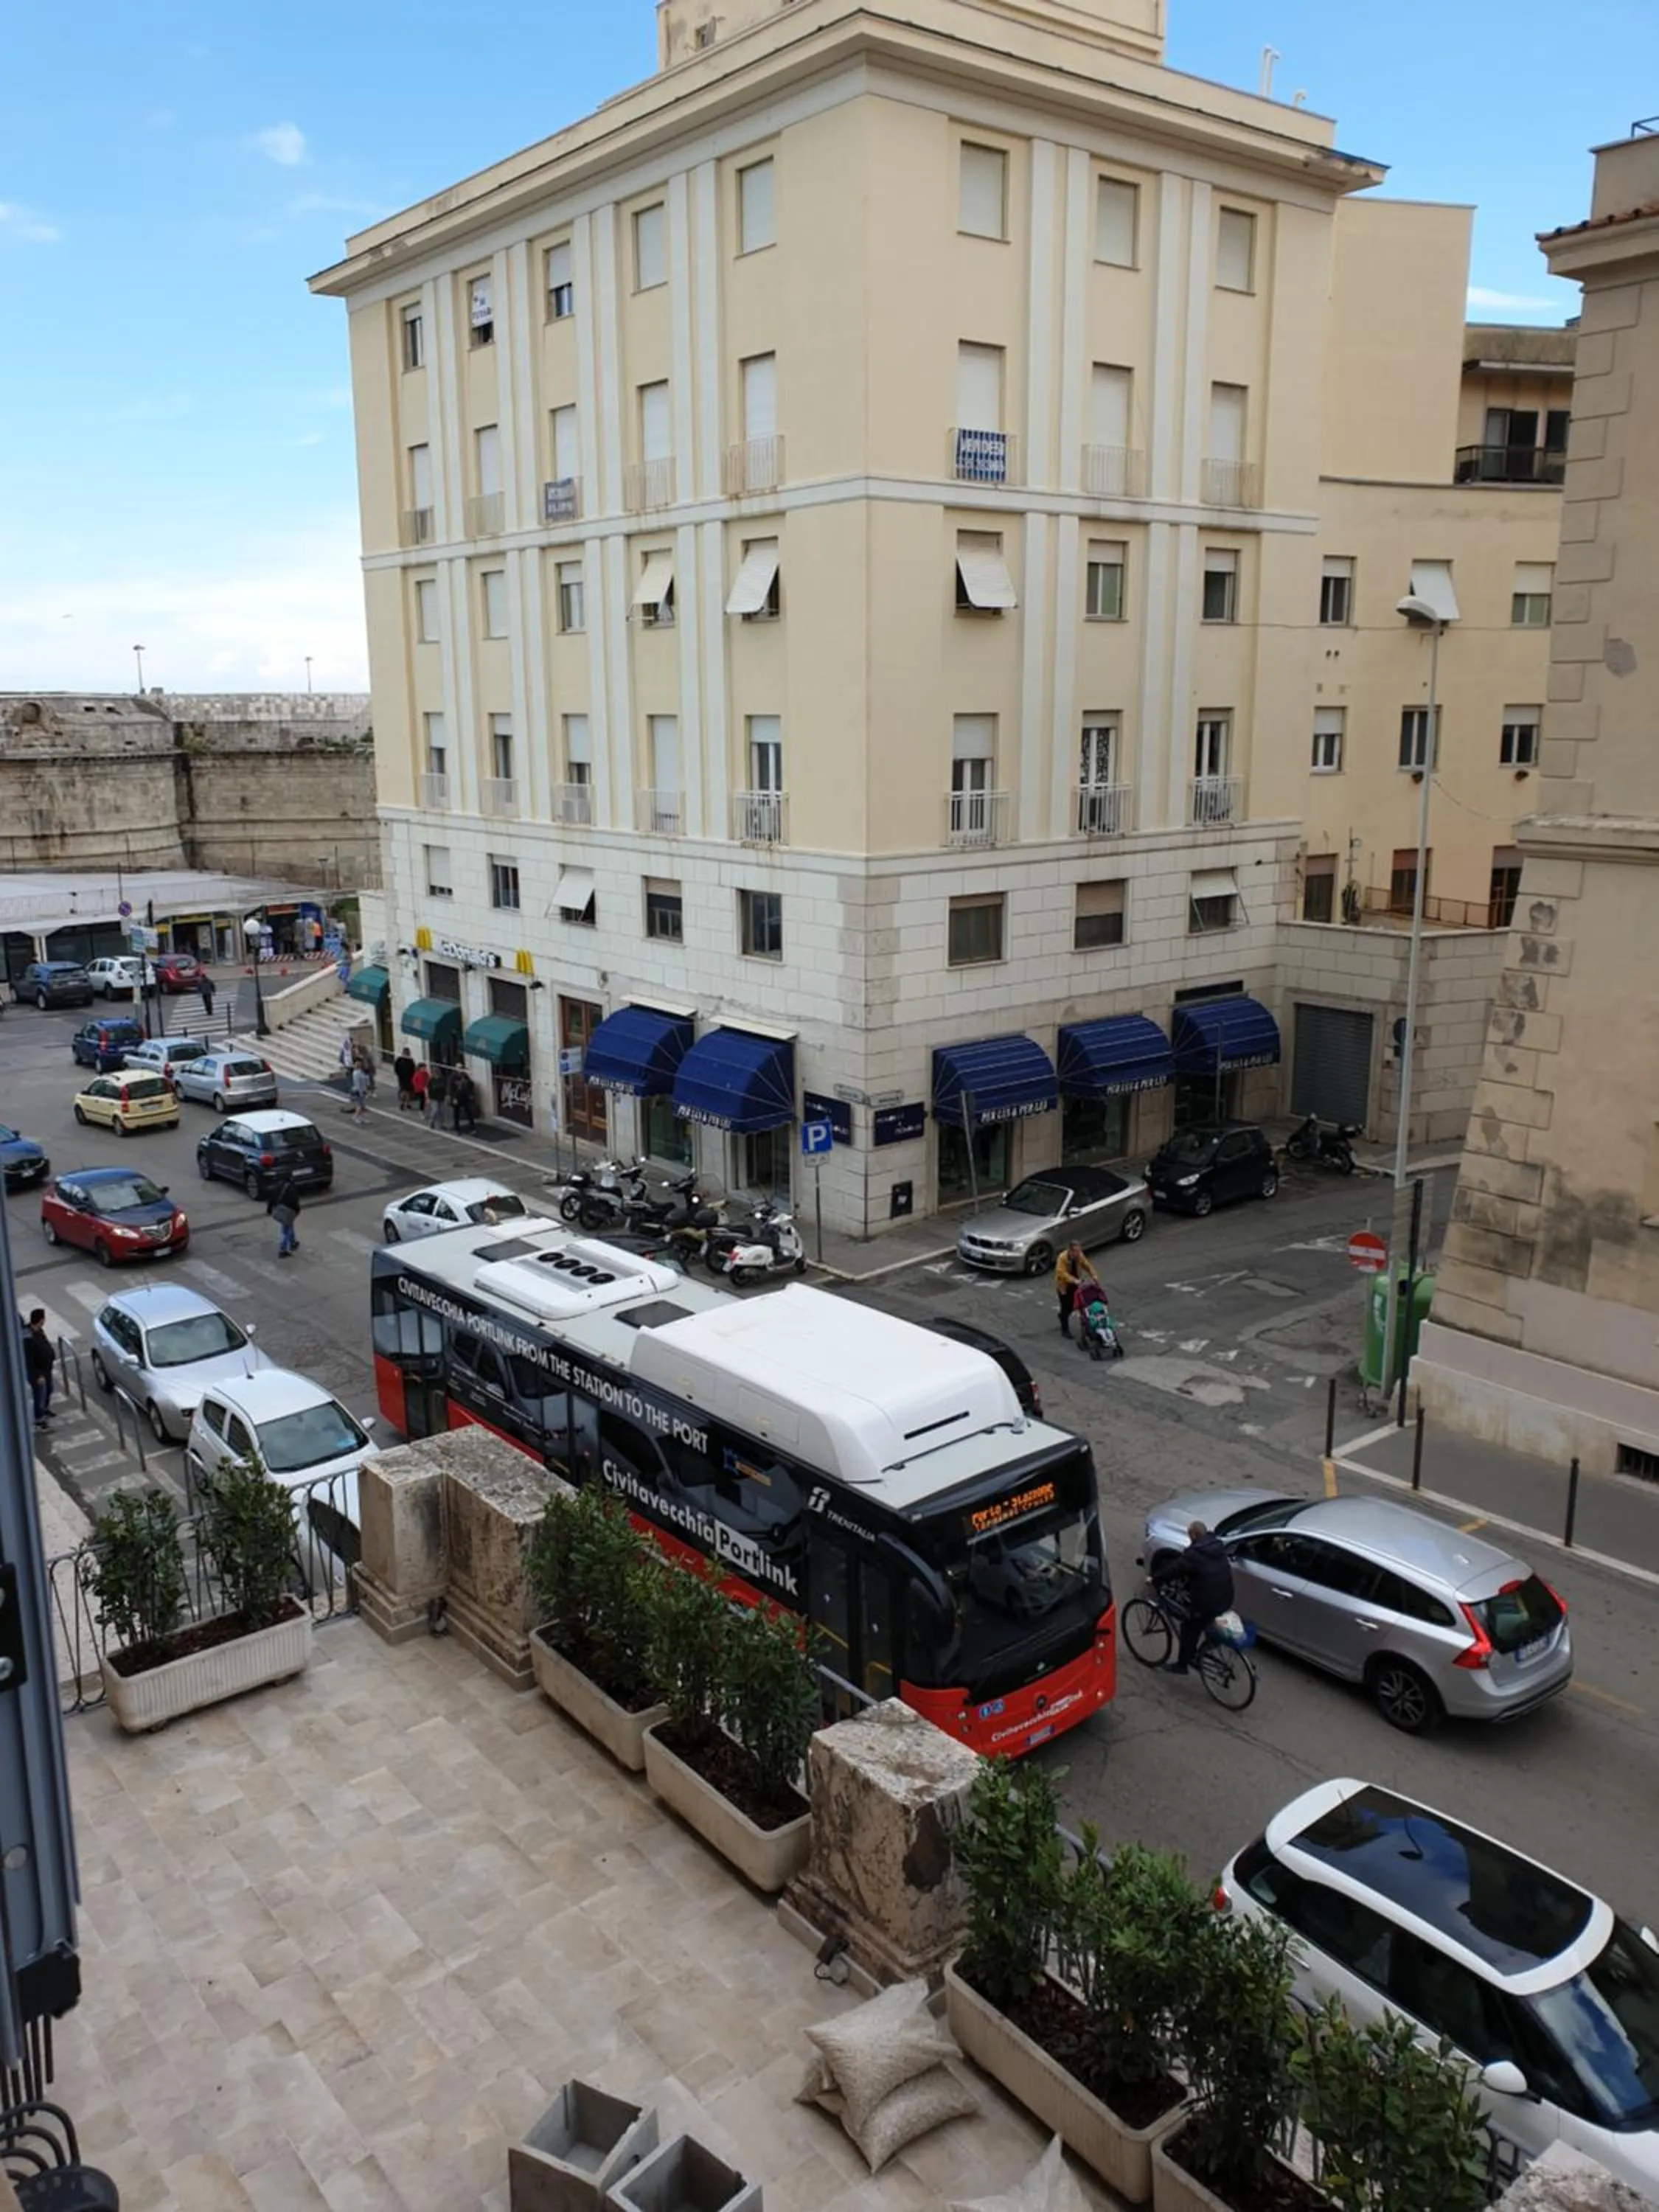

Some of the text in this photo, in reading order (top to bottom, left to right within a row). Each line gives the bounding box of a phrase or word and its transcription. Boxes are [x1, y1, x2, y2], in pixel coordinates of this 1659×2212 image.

[807, 1126, 827, 1151] P
[398, 1276, 465, 1325] CIVITAVECCHIA
[467, 1312, 515, 1352] PORTLINK
[517, 1337, 549, 1368] FROM
[549, 1354, 571, 1380] THE
[573, 1366, 623, 1408] STATION
[625, 1393, 642, 1418] TO
[644, 1403, 669, 1433] THE
[672, 1418, 708, 1453] PORT
[827, 1509, 875, 1543] TRENITALIA
